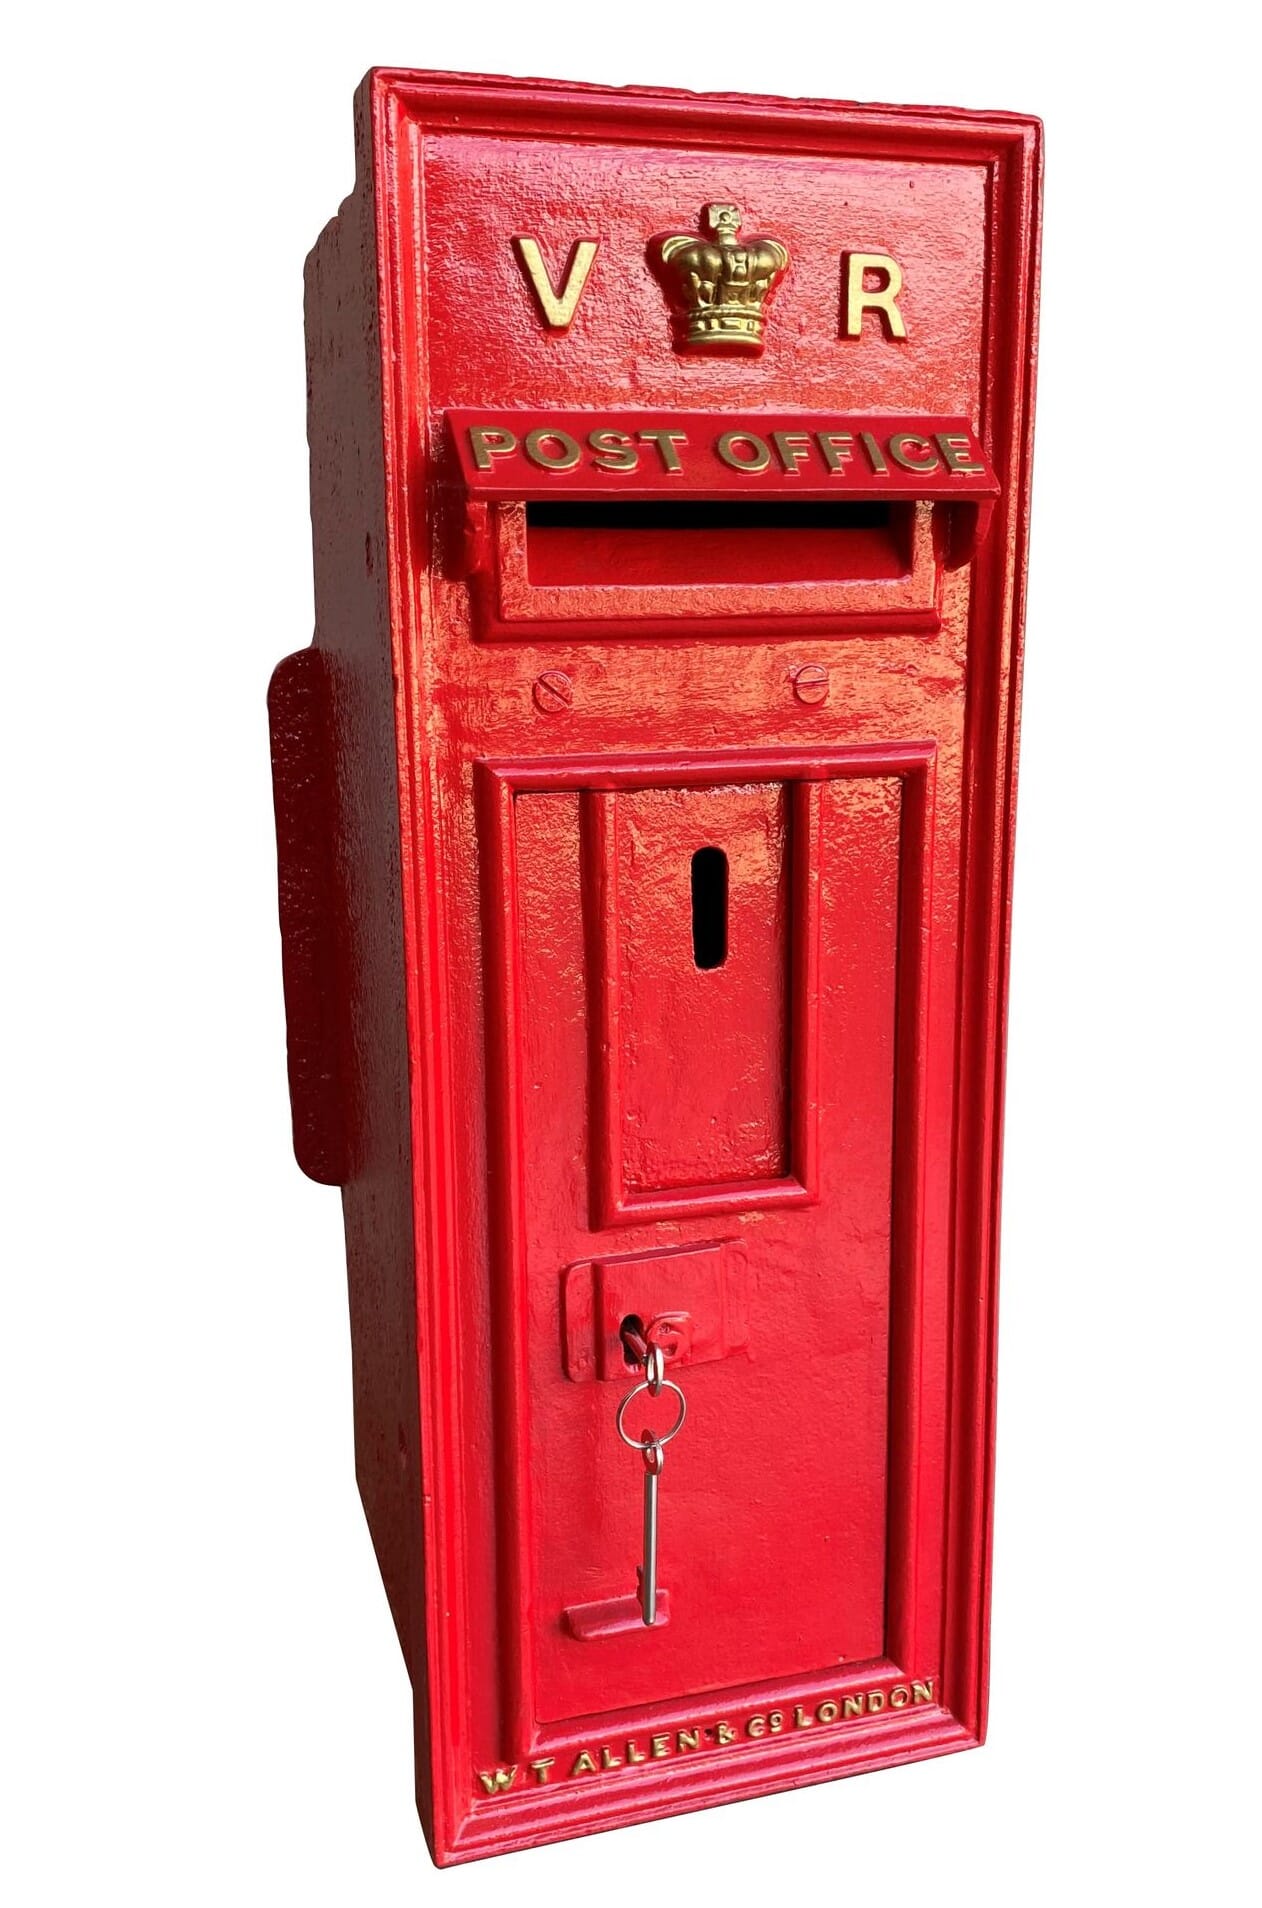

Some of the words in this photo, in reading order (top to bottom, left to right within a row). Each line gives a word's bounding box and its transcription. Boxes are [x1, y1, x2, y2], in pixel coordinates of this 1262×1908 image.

[514, 236, 598, 330] V
[844, 251, 908, 340] R
[468, 426, 686, 475] POST
[718, 429, 985, 477] OFFICE
[480, 1765, 518, 1794] W
[532, 1758, 555, 1784] T
[572, 1728, 700, 1776] ALLEN
[715, 1721, 736, 1744] &
[794, 1679, 934, 1727] LONDON
